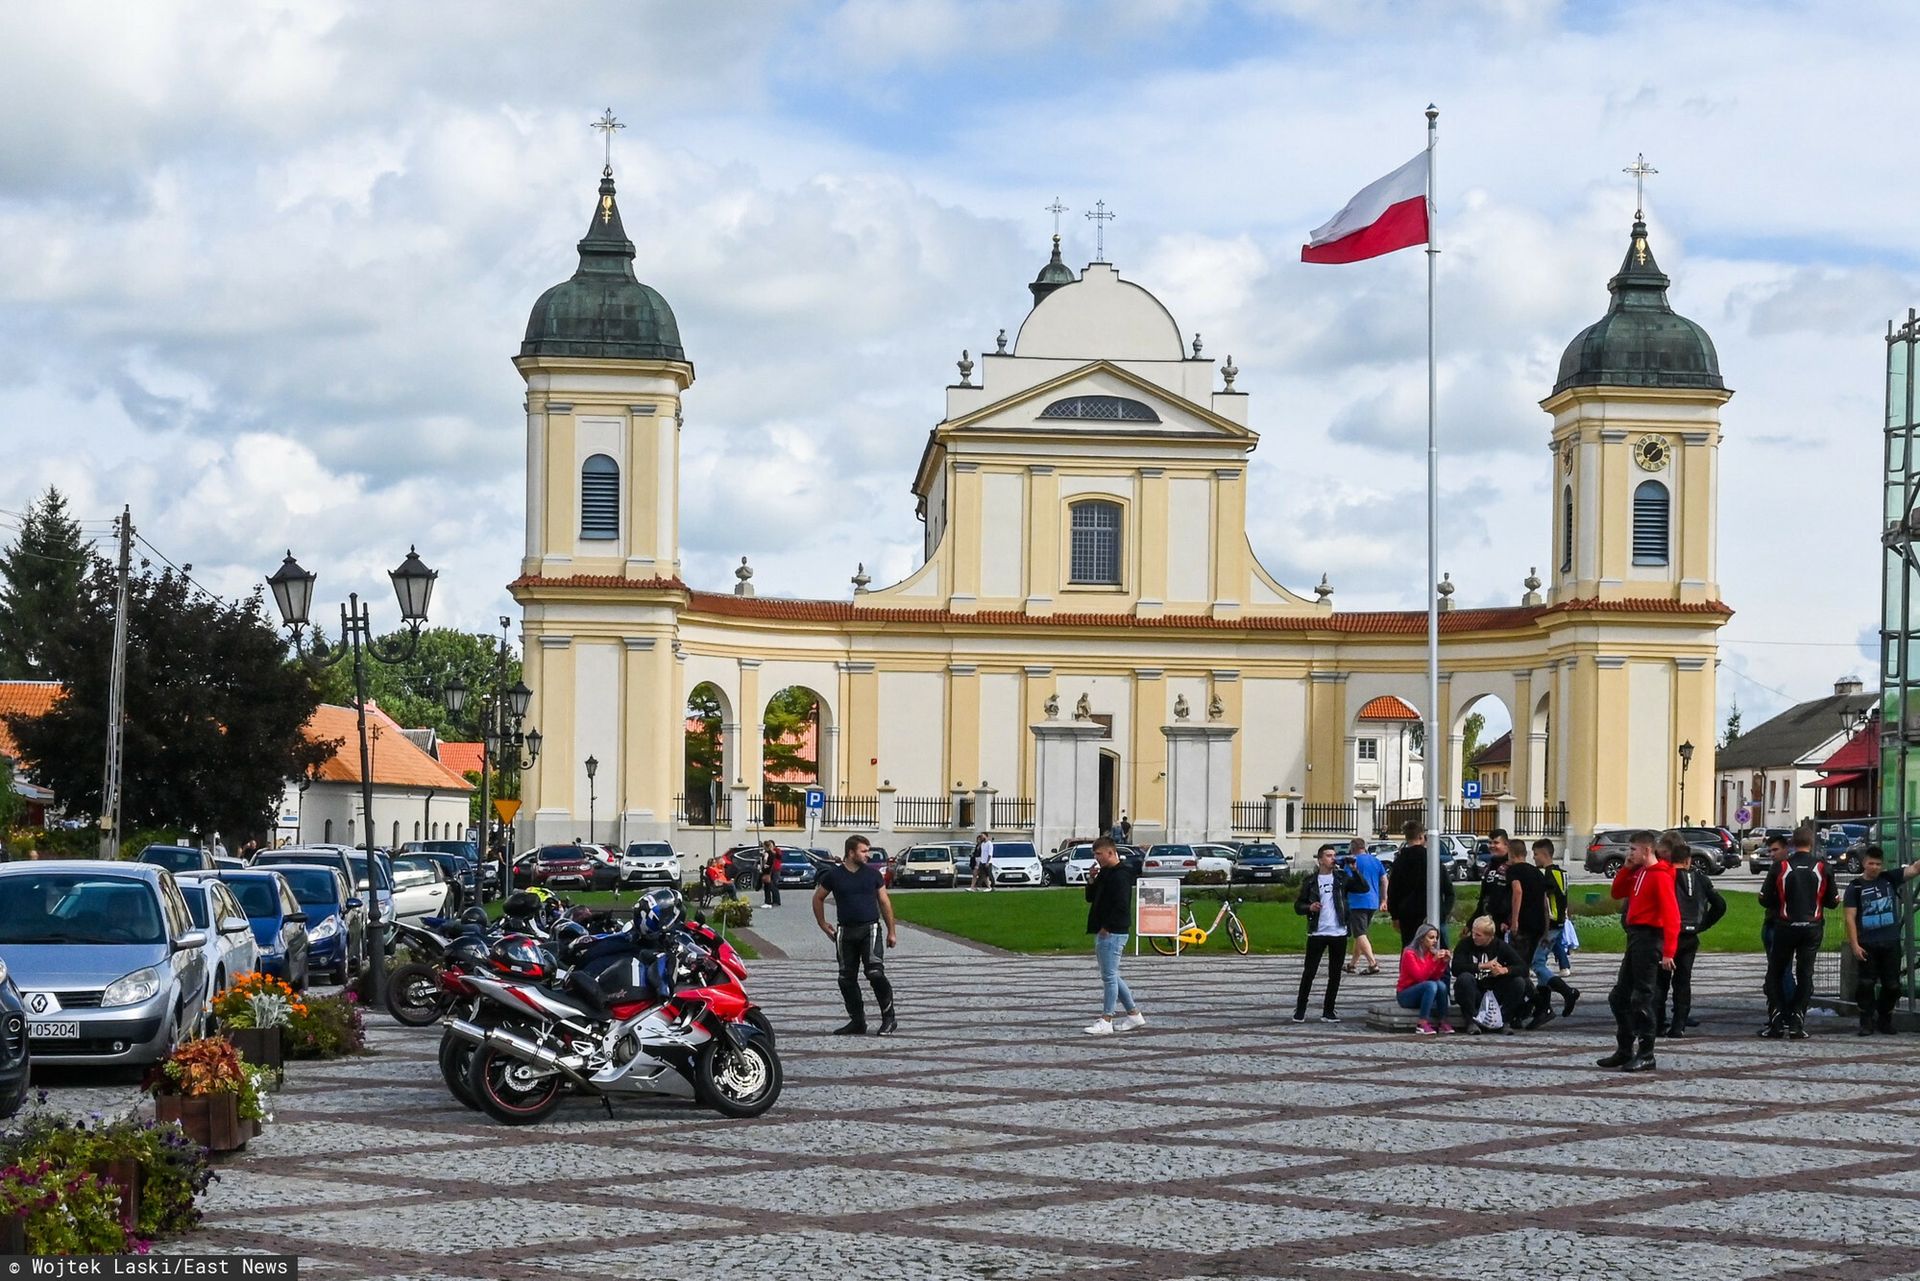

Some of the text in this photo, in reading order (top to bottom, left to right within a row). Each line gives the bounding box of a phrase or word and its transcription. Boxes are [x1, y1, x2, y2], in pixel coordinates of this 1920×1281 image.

[1467, 783, 1477, 796] P
[810, 792, 821, 806] P
[36, 1023, 75, 1036] 05204
